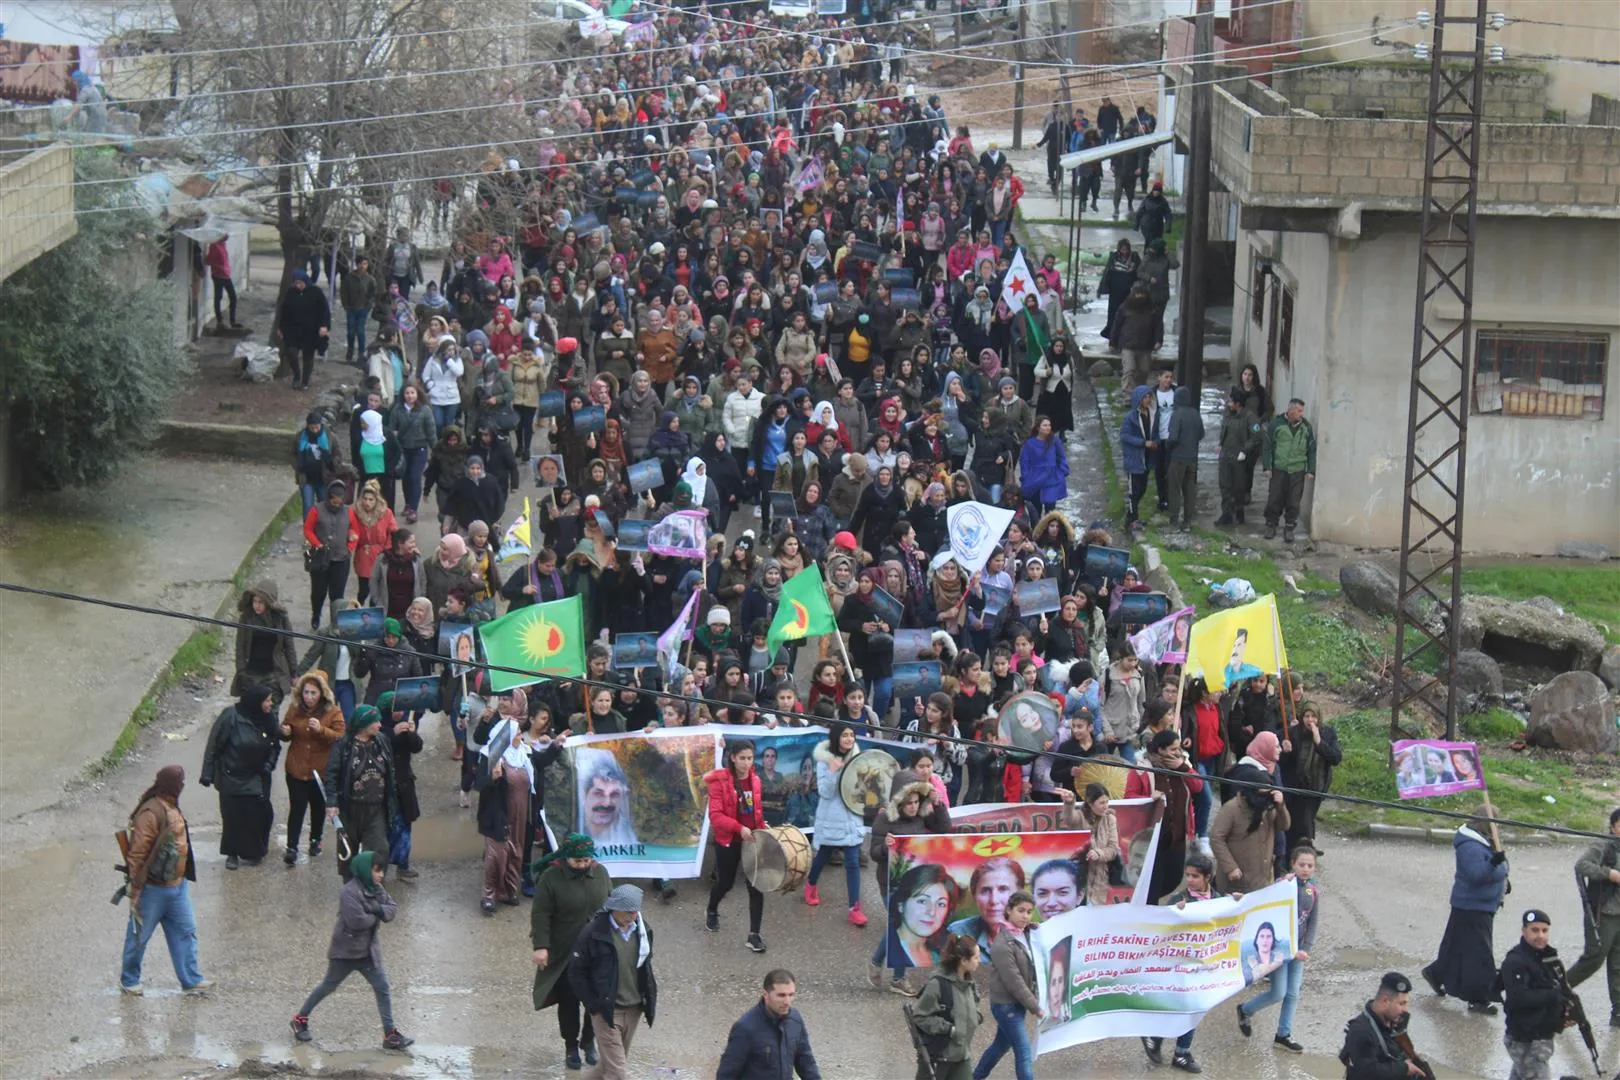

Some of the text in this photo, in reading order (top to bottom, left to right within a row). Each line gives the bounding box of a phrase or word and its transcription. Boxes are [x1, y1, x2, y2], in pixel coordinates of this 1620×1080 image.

[1077, 939, 1085, 949] BI
[1087, 934, 1110, 946] RIHÊ
[1111, 933, 1149, 945] SAKÎNE
[1084, 951, 1115, 962] BILIND
[1117, 951, 1145, 960] BIKIN
